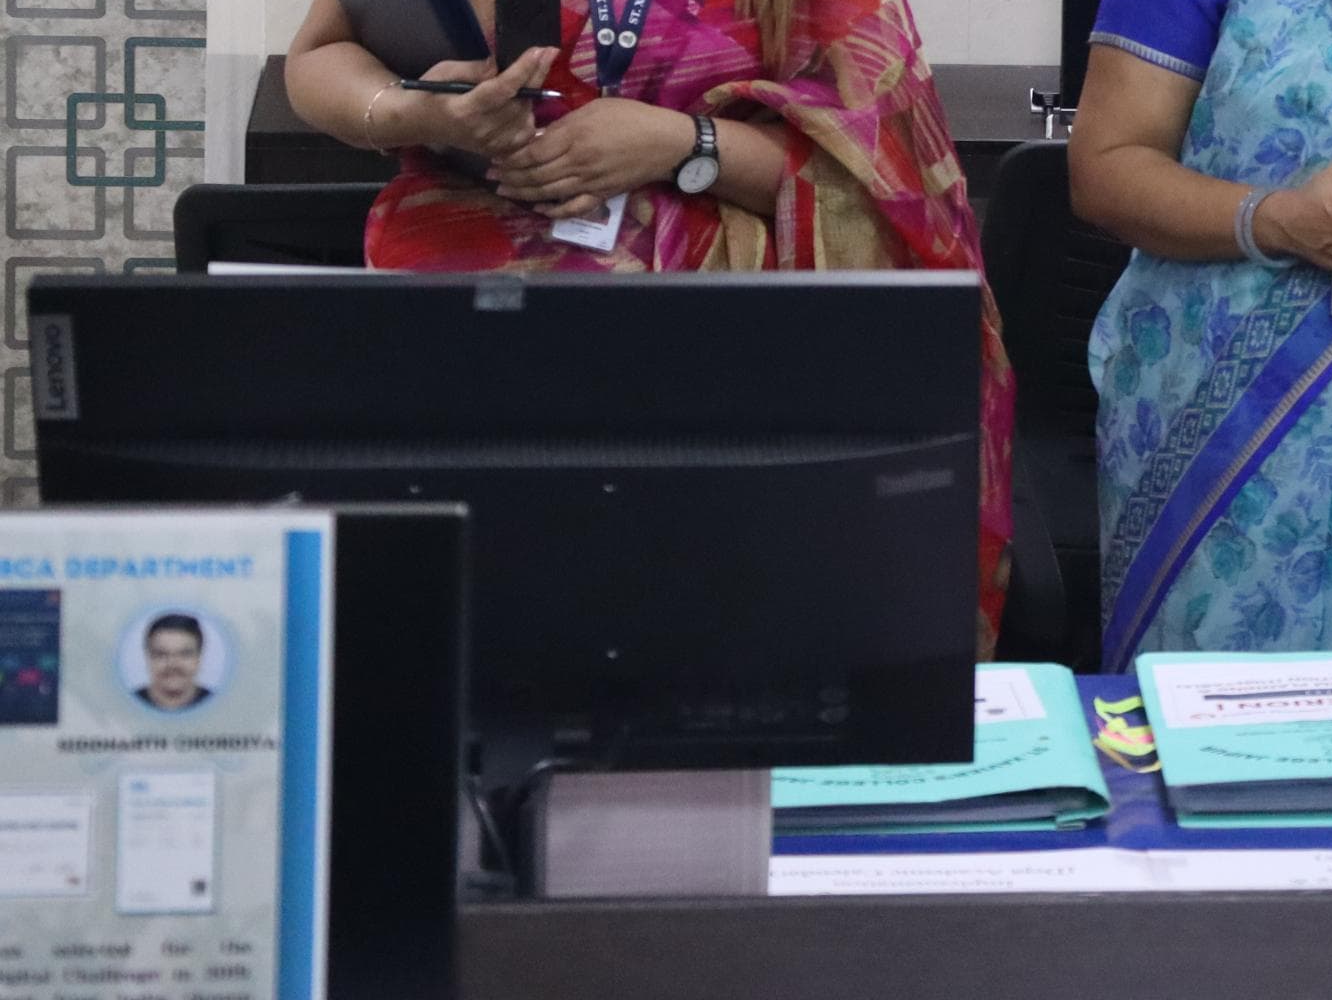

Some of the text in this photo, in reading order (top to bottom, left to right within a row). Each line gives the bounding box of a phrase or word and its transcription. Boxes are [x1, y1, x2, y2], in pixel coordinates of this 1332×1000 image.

[598, 4, 609, 22] ST.
[628, 6, 640, 25] ST.
[45, 323, 66, 409] Lenovo
[64, 556, 255, 580] DEPARTMENT
